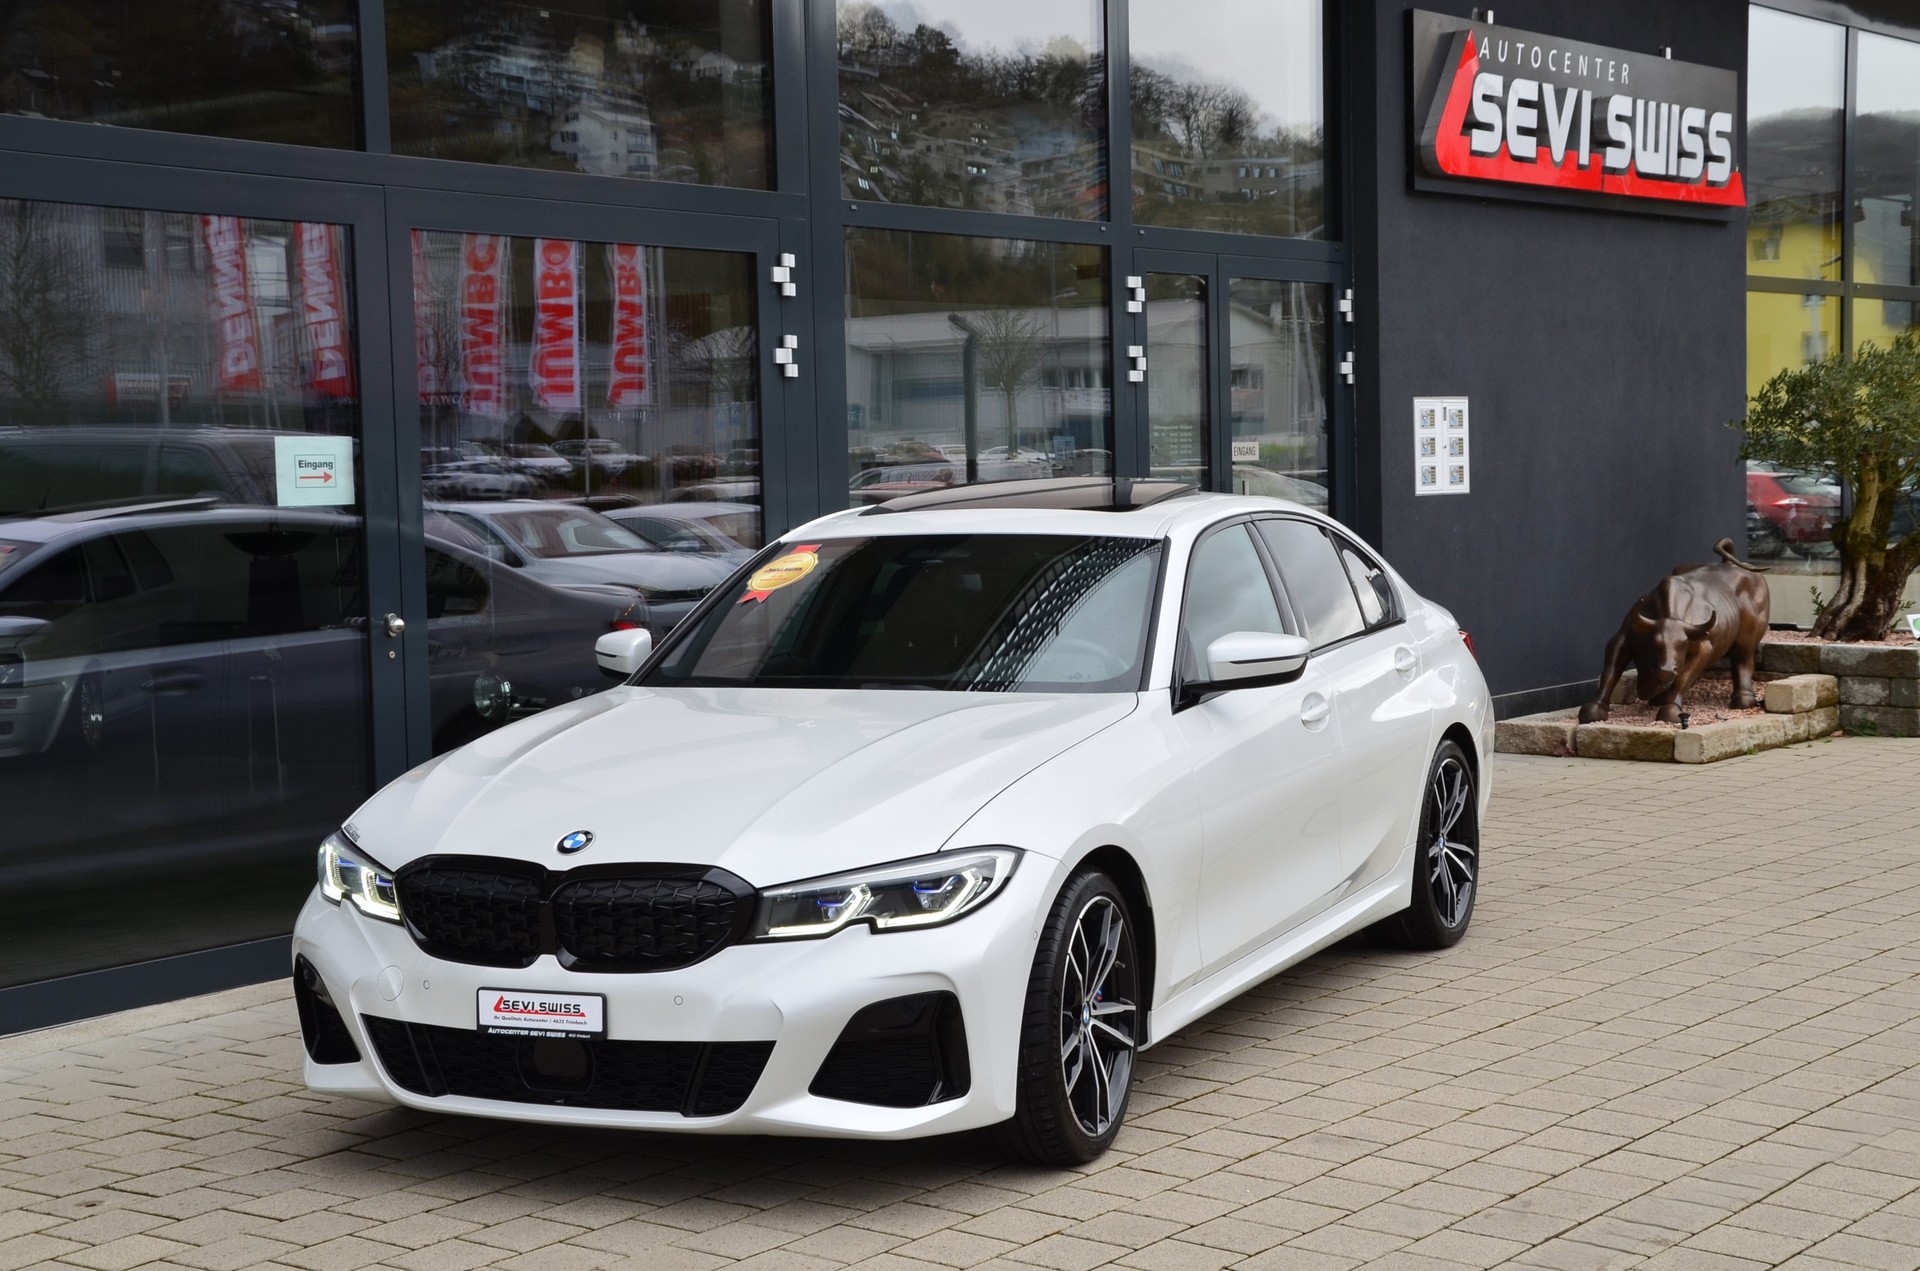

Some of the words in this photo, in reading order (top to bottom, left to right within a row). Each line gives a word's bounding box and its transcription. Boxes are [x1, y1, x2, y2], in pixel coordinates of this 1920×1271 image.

[1479, 36, 1631, 85] AUTOCENTER
[1471, 72, 1592, 167] SEVI
[1605, 94, 1733, 183] SWISS
[1234, 446, 1256, 456] EINGANG
[298, 460, 333, 470] Eingang
[502, 1000, 535, 1011] SEVI
[539, 1002, 581, 1014] SWISS
